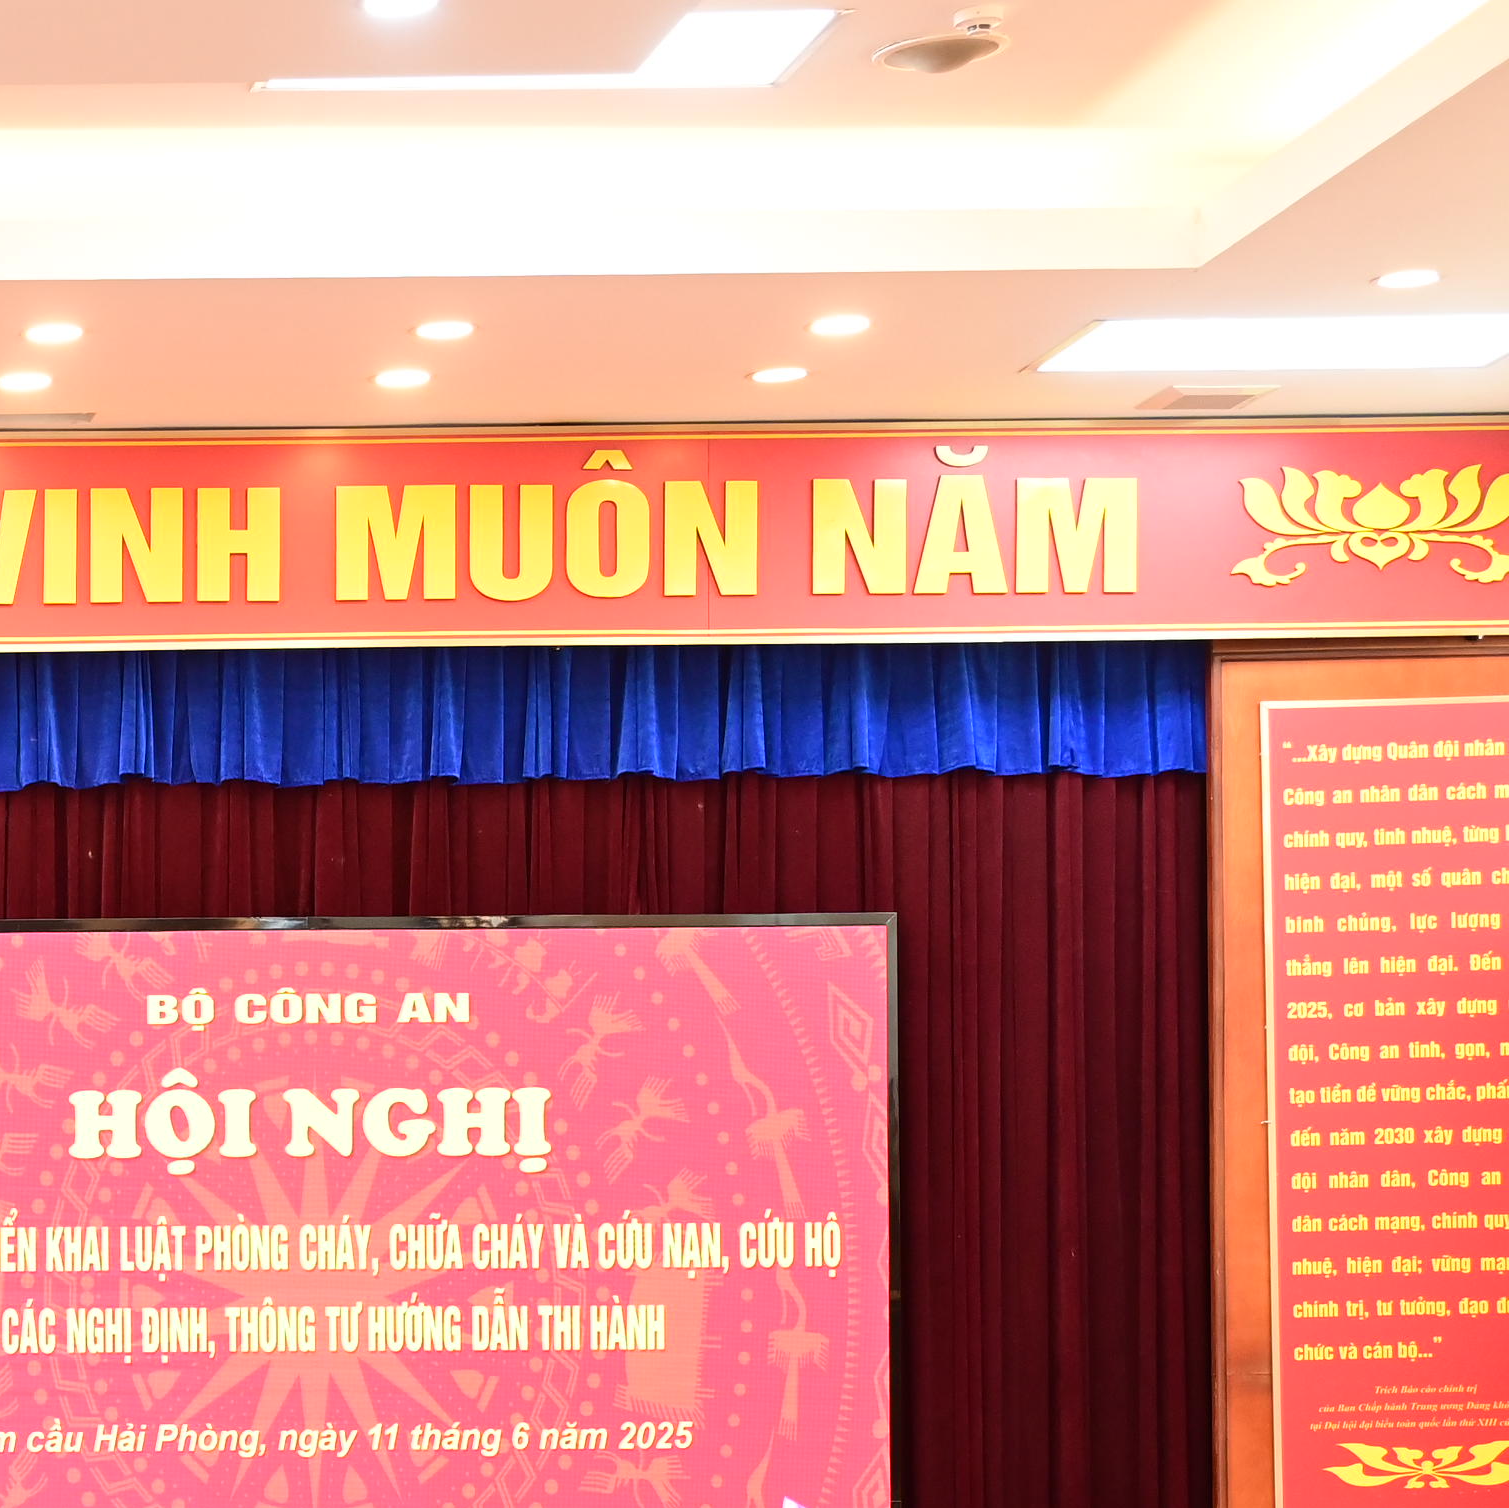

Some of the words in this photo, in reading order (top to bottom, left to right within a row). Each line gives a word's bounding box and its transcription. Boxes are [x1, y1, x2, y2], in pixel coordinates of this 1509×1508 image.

[336, 450, 757, 601] MUÔN
[813, 446, 1139, 594] NĂM
[1284, 788, 1324, 806] Công
[1333, 790, 1352, 803] an
[1360, 785, 1400, 803] nhân
[1408, 784, 1438, 801] dân
[1446, 783, 1486, 800] cách
[1344, 957, 1369, 974] lên
[1381, 956, 1416, 976] hiện
[1428, 955, 1458, 975] đại.
[1470, 951, 1501, 970] Đến
[147, 988, 214, 1031] BỘ
[235, 988, 376, 1024] CÔNG
[397, 993, 469, 1022] AN
[1287, 1002, 1332, 1019] 2025,
[1375, 997, 1405, 1016] bản
[1457, 998, 1497, 1017] dựng
[69, 1068, 256, 1175] HỘI
[283, 1087, 551, 1172] NGHỊ
[1291, 1127, 1320, 1146] đến
[1330, 1128, 1365, 1145] năm
[1462, 1126, 1502, 1146] dựng
[1292, 1172, 1316, 1192] đội
[1329, 1171, 1368, 1188] nhân
[1381, 1170, 1415, 1188] dân,
[1428, 1169, 1469, 1187] Công
[1482, 1171, 1501, 1185] an
[46, 1226, 109, 1272] KHAI
[120, 1216, 186, 1281] LUẬT
[195, 1214, 288, 1270] PHÒNG
[300, 1215, 378, 1275] CHÁY,
[389, 1213, 463, 1270] CHỮA
[472, 1214, 543, 1269] CHÁY
[554, 1214, 589, 1268] VÀ
[598, 1210, 652, 1269] CỨU
[663, 1223, 729, 1278] NẠN,
[740, 1209, 793, 1268] CỨU
[805, 1212, 840, 1277] HỘ
[2, 1299, 55, 1354] CÁC
[66, 1308, 131, 1363] NGHỊ
[141, 1307, 215, 1363] ĐỊNH,
[225, 1297, 315, 1352] THÔNG
[325, 1302, 362, 1352] TƯ
[368, 1292, 461, 1351] HƯỚNG
[472, 1288, 528, 1350] DẪN
[538, 1305, 580, 1350] THI
[590, 1295, 664, 1350] HÀNH
[27, 1418, 83, 1452] cầu
[94, 1423, 146, 1452] Hải
[155, 1424, 265, 1457] Phòng,
[278, 1423, 357, 1457] ngày
[368, 1423, 398, 1450] 11
[411, 1422, 501, 1456] tháng
[512, 1422, 530, 1449] 6
[540, 1422, 607, 1449] năm
[619, 1421, 693, 1449] 2025
